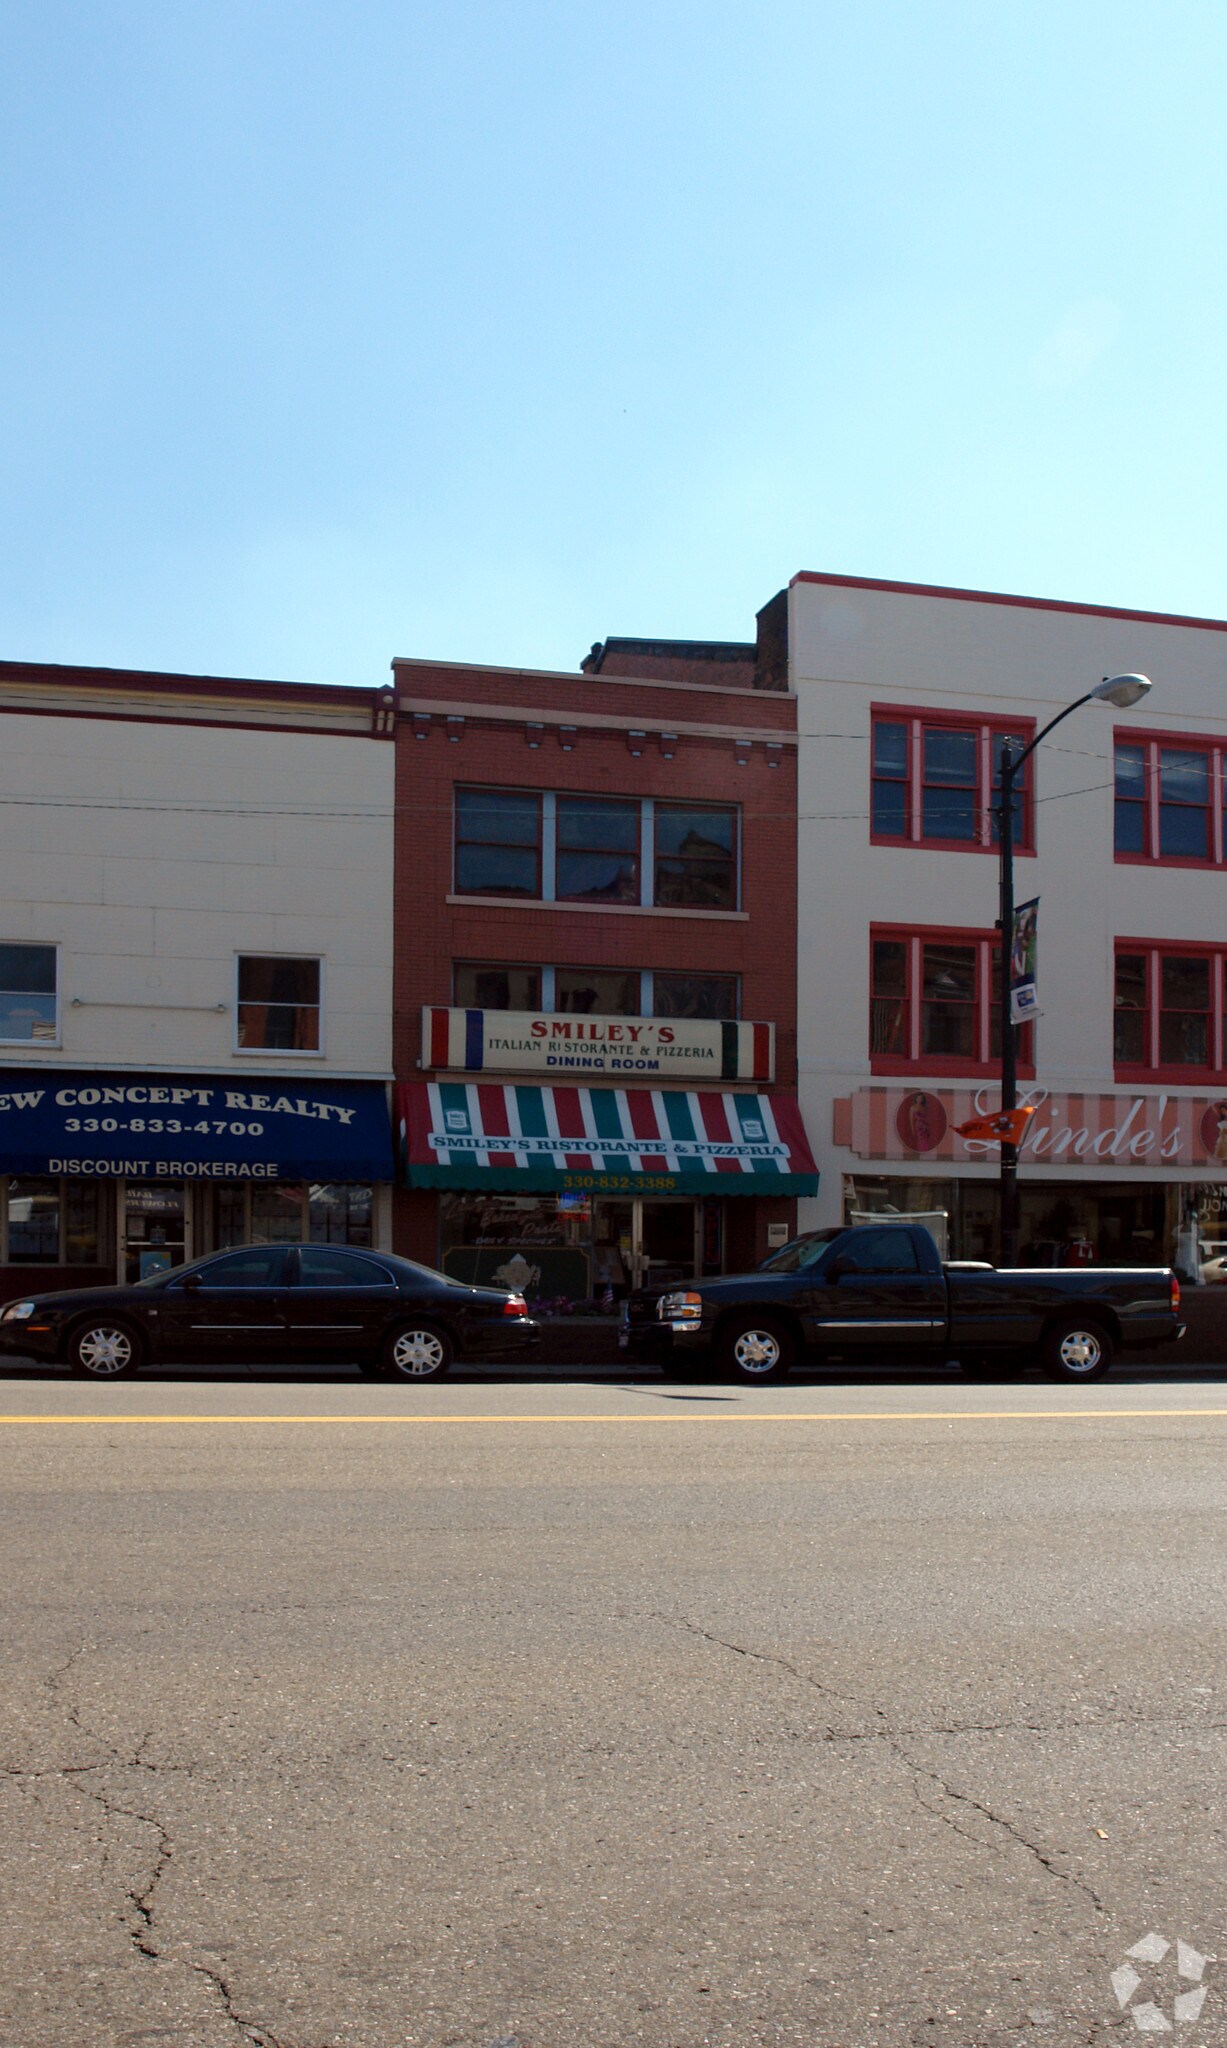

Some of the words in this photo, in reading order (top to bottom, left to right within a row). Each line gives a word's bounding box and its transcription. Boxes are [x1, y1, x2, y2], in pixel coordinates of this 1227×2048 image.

[530, 1020, 676, 1044] SMILEY'S
[488, 1038, 541, 1052] ITALIAN
[639, 1045, 650, 1056] &
[656, 1046, 714, 1058] PIZZERIA
[546, 1055, 604, 1068] DINING
[611, 1058, 660, 1070] ROOM
[55, 1086, 215, 1107] CONCEPT
[224, 1091, 357, 1125] REALTY
[64, 1118, 265, 1137] 330-833-4700
[433, 1136, 531, 1151] SMILEY'S
[537, 1140, 667, 1153] RISTORANTE
[673, 1143, 688, 1154] &
[693, 1143, 785, 1156] PIZZERIA
[49, 1158, 150, 1175] DISCOUNT
[155, 1160, 279, 1178] BROKERAGE
[563, 1175, 676, 1190] 330-832-3388
